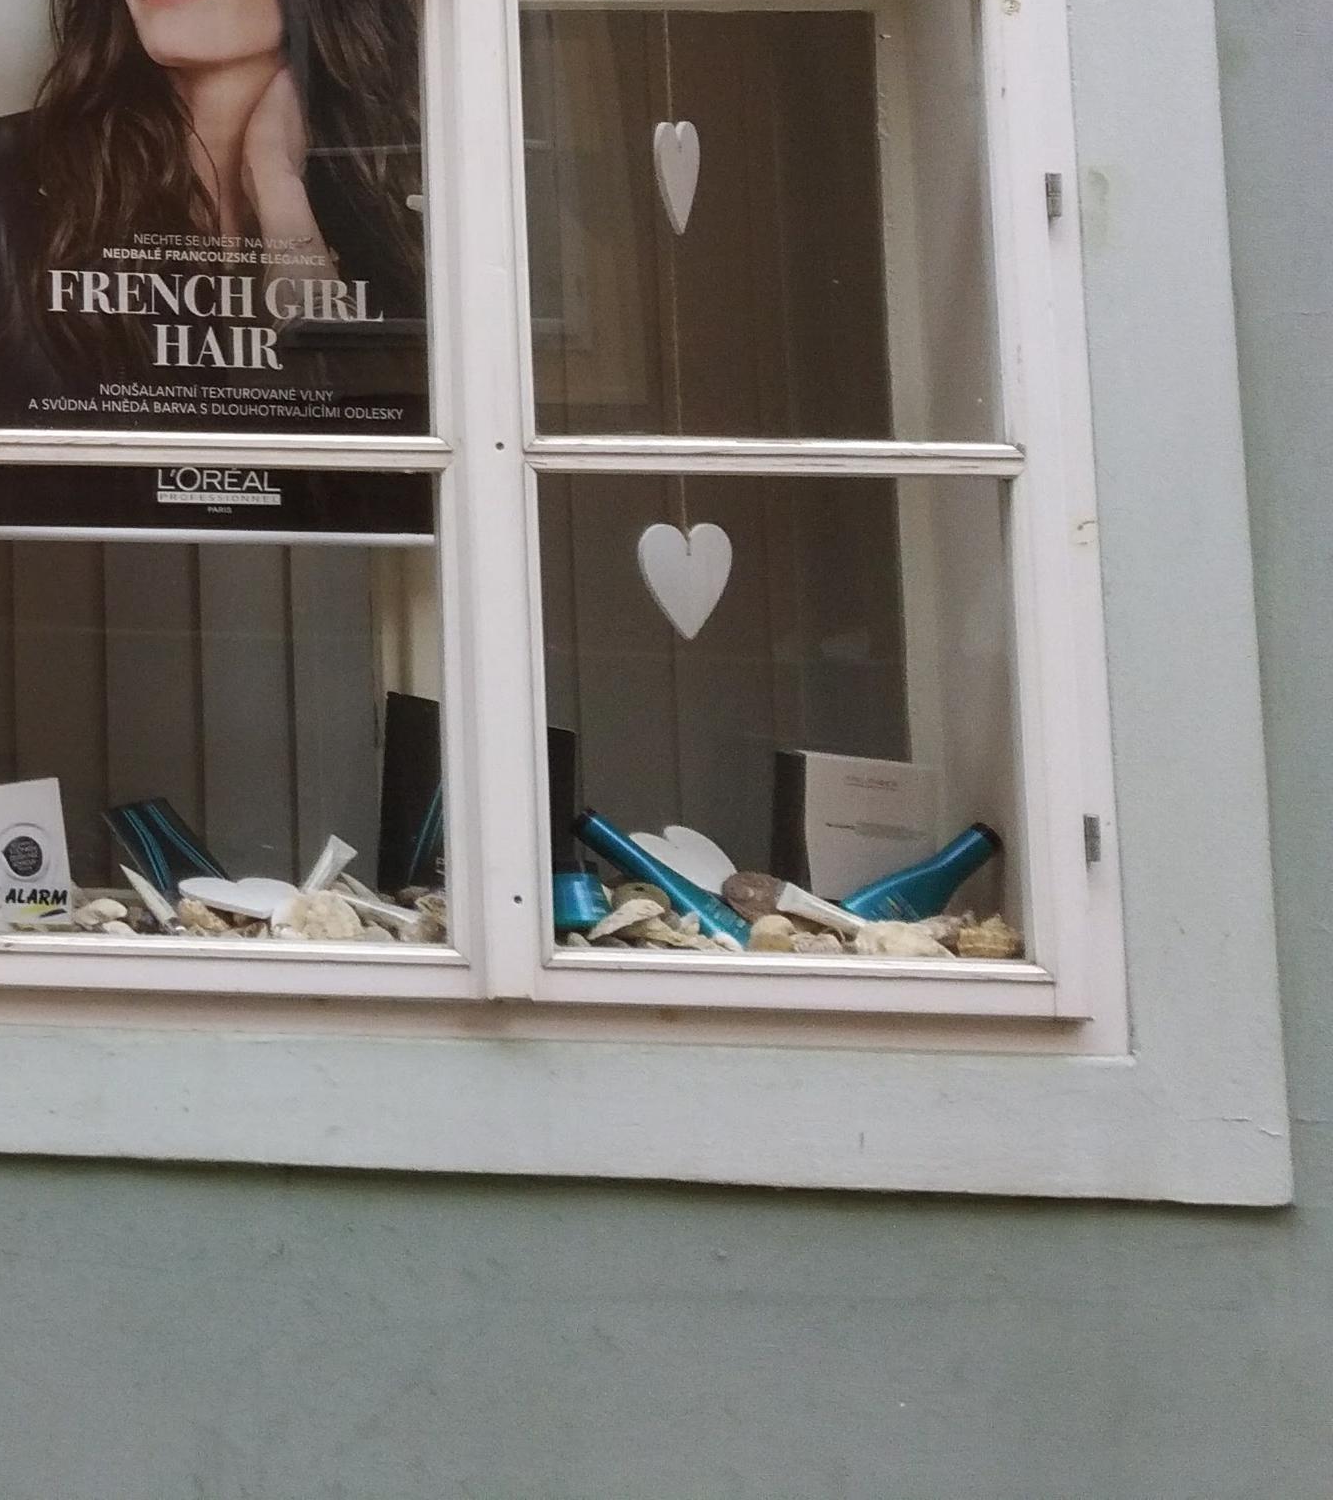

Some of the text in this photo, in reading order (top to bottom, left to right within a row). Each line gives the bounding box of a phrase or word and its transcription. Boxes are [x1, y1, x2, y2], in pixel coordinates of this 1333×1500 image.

[133, 233, 182, 245] NECHTE
[184, 235, 199, 247] SE
[244, 236, 263, 249] NA
[102, 246, 326, 267] NEDBALÉ FRANCOUZSKÉ ELEGANCE
[47, 269, 384, 323] FRENCH GIRL
[152, 322, 284, 370] HAIR
[99, 382, 334, 402] NONŠALANTNÍ TEXTUROVANÉ VLNY
[28, 398, 39, 410] A
[42, 396, 98, 411] SVŮDNÁ
[102, 398, 149, 413] HNĚDÁ
[153, 401, 197, 414] BARVA
[200, 402, 208, 415] S
[344, 407, 404, 420] ODLESKY
[158, 492, 280, 505] PROFESSIONNEL
[207, 506, 233, 514] PARIS
[5, 888, 68, 905] ALARM
